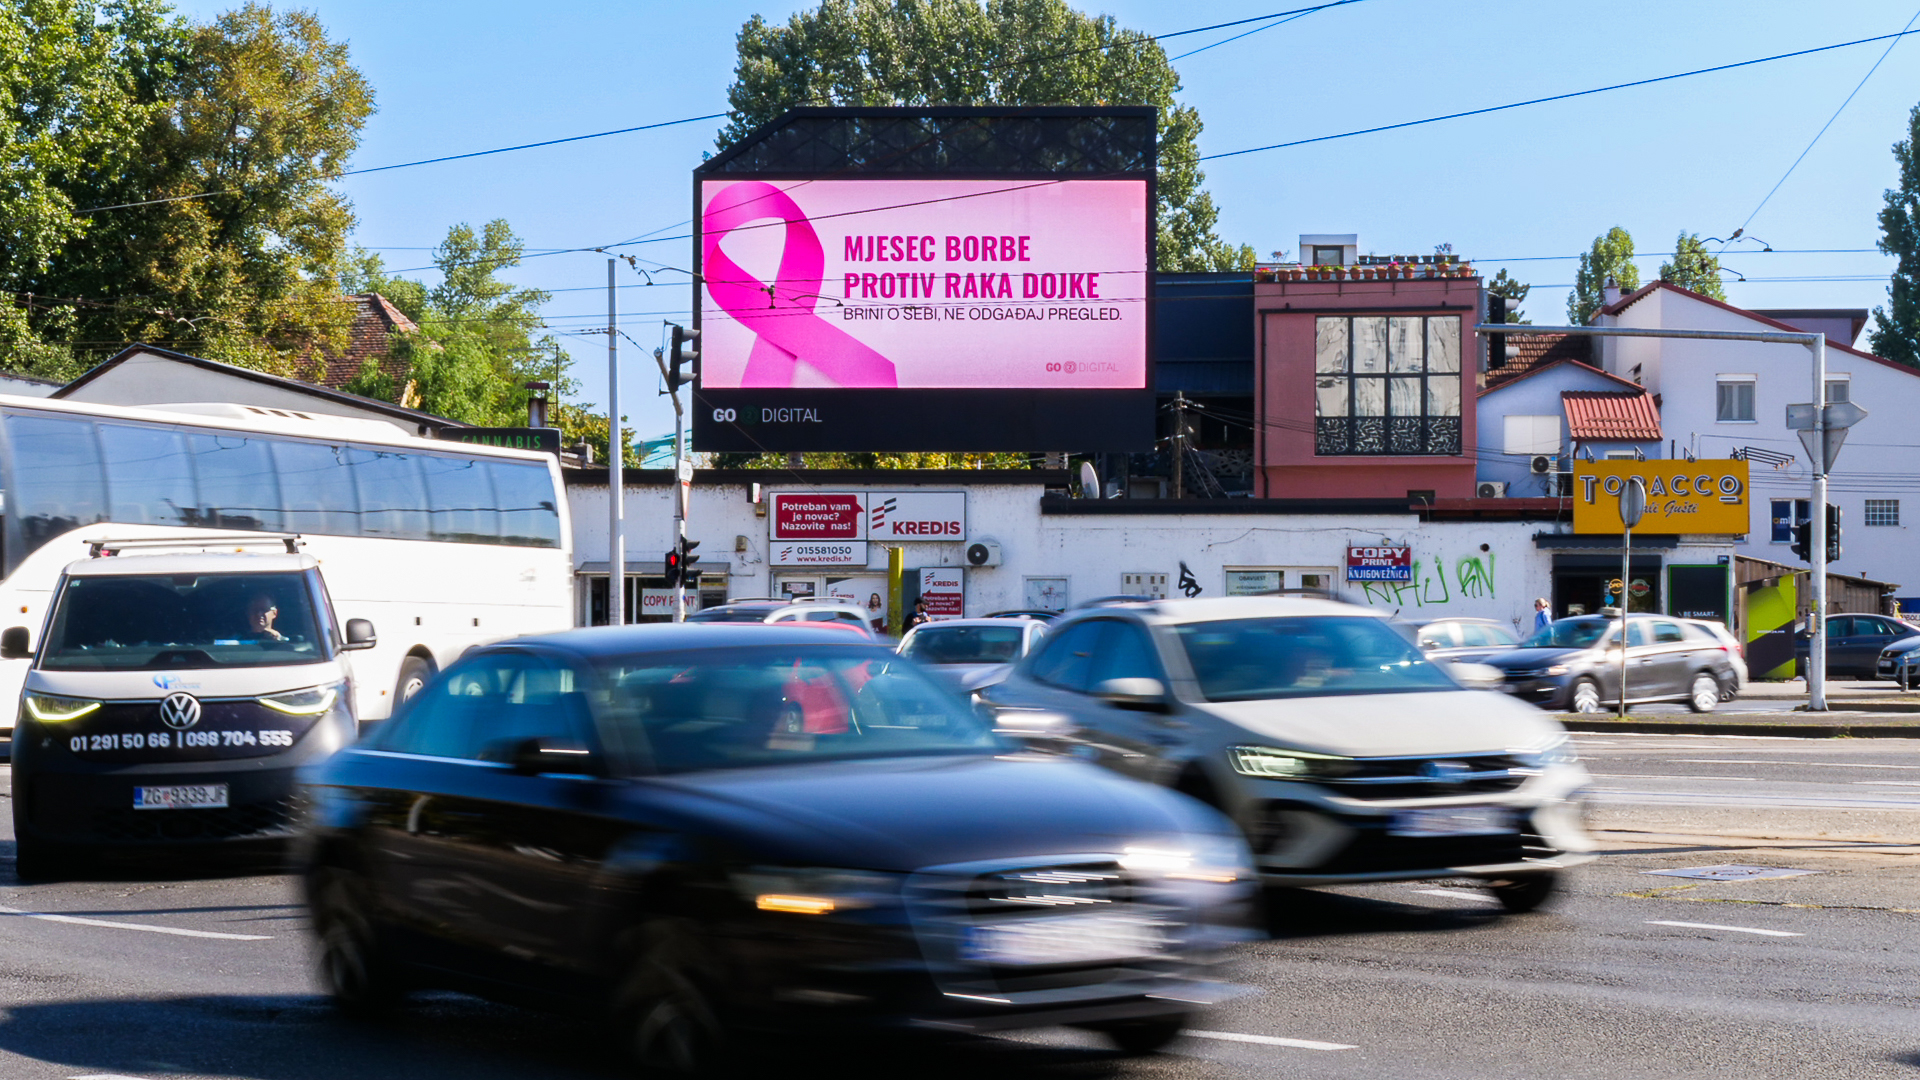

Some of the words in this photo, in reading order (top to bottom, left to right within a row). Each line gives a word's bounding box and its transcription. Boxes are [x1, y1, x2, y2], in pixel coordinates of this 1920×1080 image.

[844, 235, 936, 262] MJESEC
[945, 235, 1031, 262] BORBE
[844, 272, 936, 299] PROTIV
[945, 272, 1013, 299] RAKA
[1022, 272, 1100, 299] DOJKE
[843, 307, 883, 320] BRINI
[887, 307, 900, 320] O
[903, 307, 941, 321] SEBI,
[944, 307, 965, 320] NE
[968, 307, 1045, 321] ODGAĐAJ
[1048, 307, 1123, 321] PREGLED.
[1045, 361, 1062, 372] GO
[1079, 362, 1119, 372] DIGITAL
[712, 408, 737, 422] GO
[761, 408, 822, 422] DIGITAL
[781, 502, 827, 511] Potreban
[829, 503, 851, 511] vam
[792, 513, 803, 522] je
[804, 513, 840, 521] novac?
[781, 522, 825, 531] Nazovite
[830, 522, 851, 531] nas!
[891, 521, 961, 535] KREDIS
[796, 546, 852, 556] 015581050
[1351, 548, 1406, 559] COPY
[796, 556, 852, 564] www.kredis.hr
[643, 595, 667, 607] COPY
[668, 595, 696, 607] PNT
[70, 737, 88, 752] 01
[90, 734, 119, 750] 291
[121, 734, 145, 748] 50
[147, 732, 171, 748] 66
[185, 731, 219, 747] 098
[221, 730, 256, 746] 704
[258, 730, 294, 746] 555
